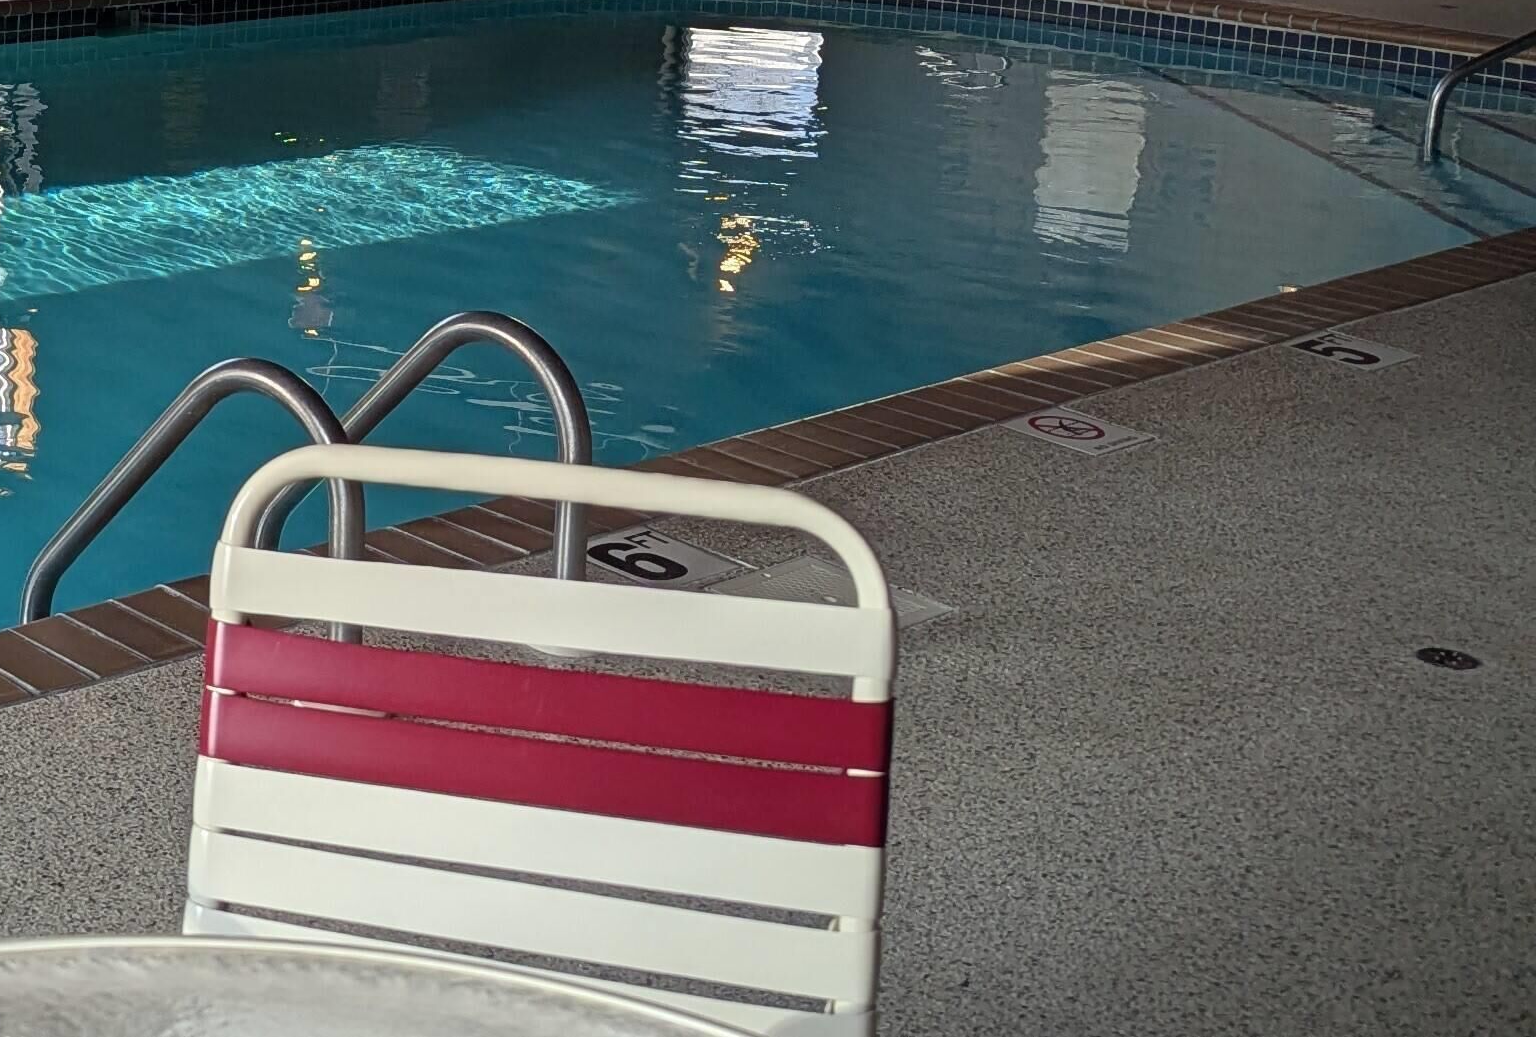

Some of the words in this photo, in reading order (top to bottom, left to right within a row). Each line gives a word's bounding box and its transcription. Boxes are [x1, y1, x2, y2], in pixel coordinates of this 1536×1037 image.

[1290, 339, 1381, 365] 5
[624, 530, 670, 549] FT
[587, 542, 689, 581] 6
